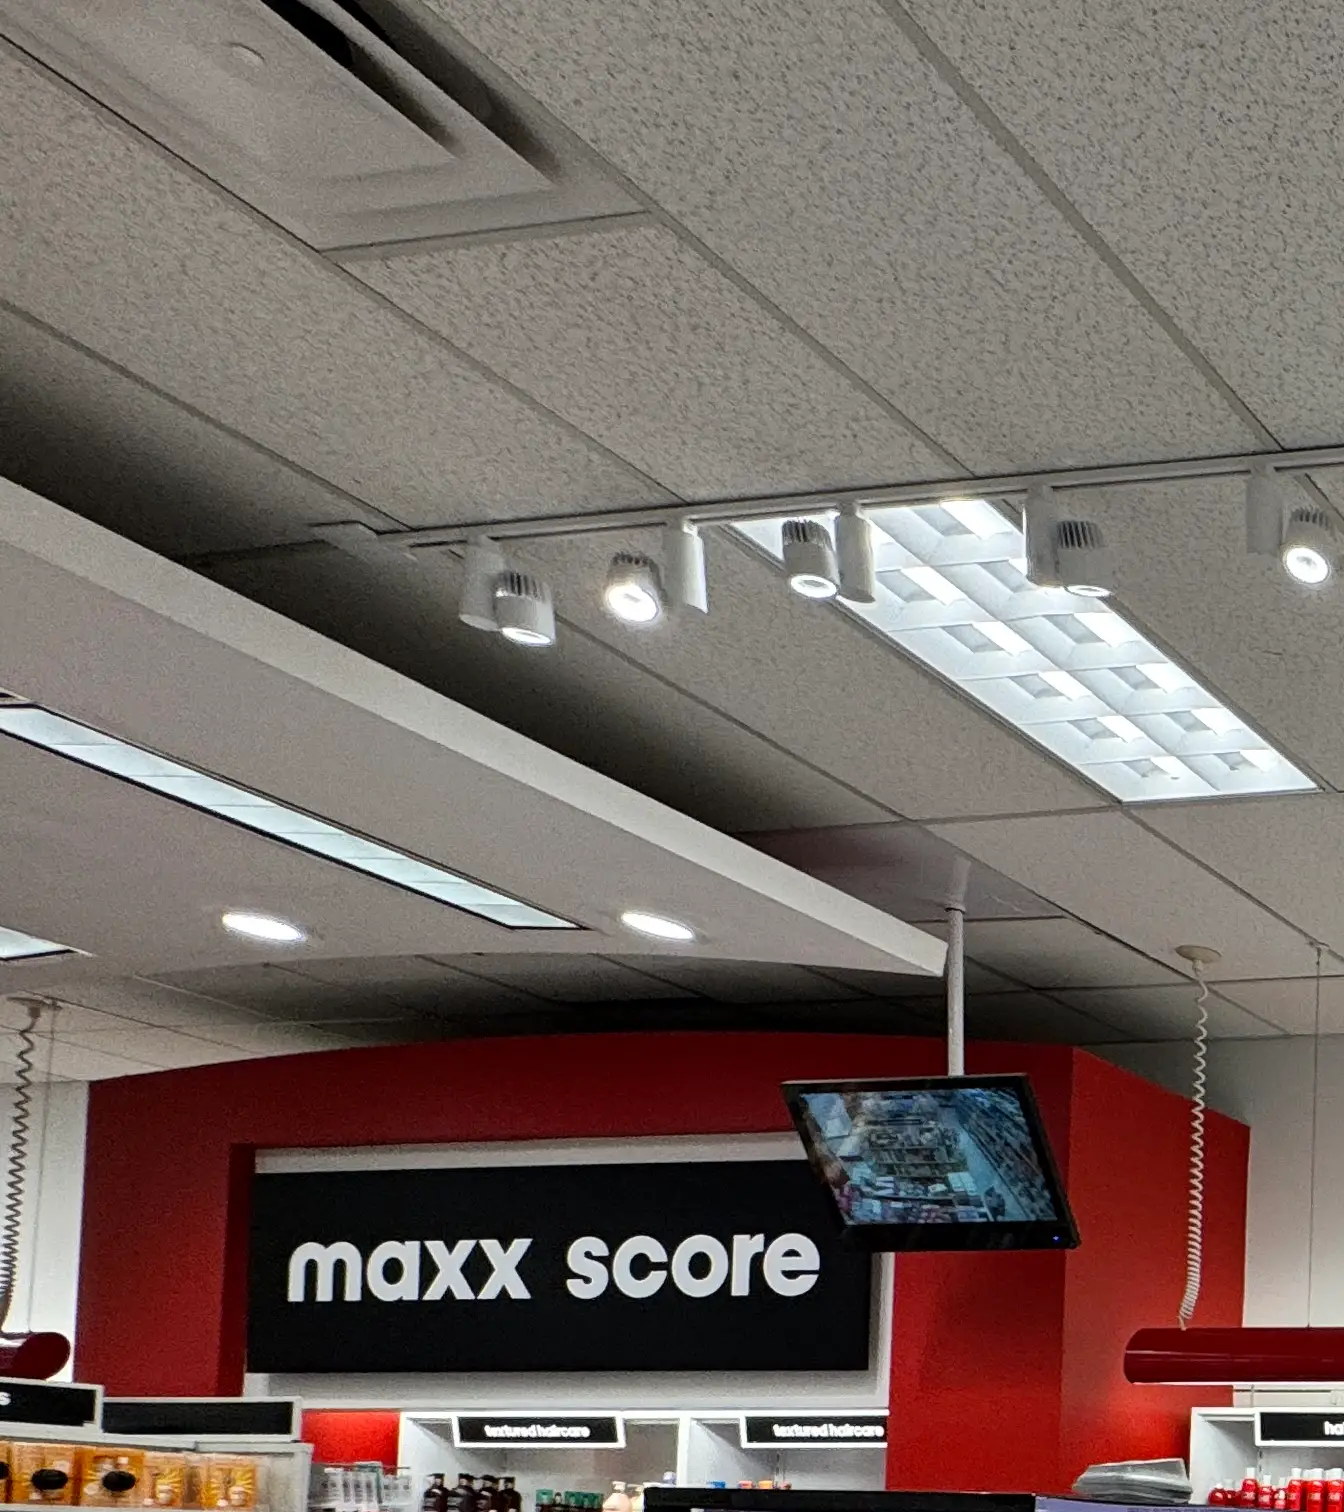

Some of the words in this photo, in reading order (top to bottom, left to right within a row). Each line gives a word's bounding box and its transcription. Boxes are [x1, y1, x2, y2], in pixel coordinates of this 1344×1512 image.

[287, 1238, 533, 1304] maxx
[565, 1232, 821, 1301] score
[484, 1425, 537, 1438] textured
[537, 1425, 591, 1438] haircare
[773, 1424, 829, 1438] textured
[829, 1423, 885, 1438] haircare
